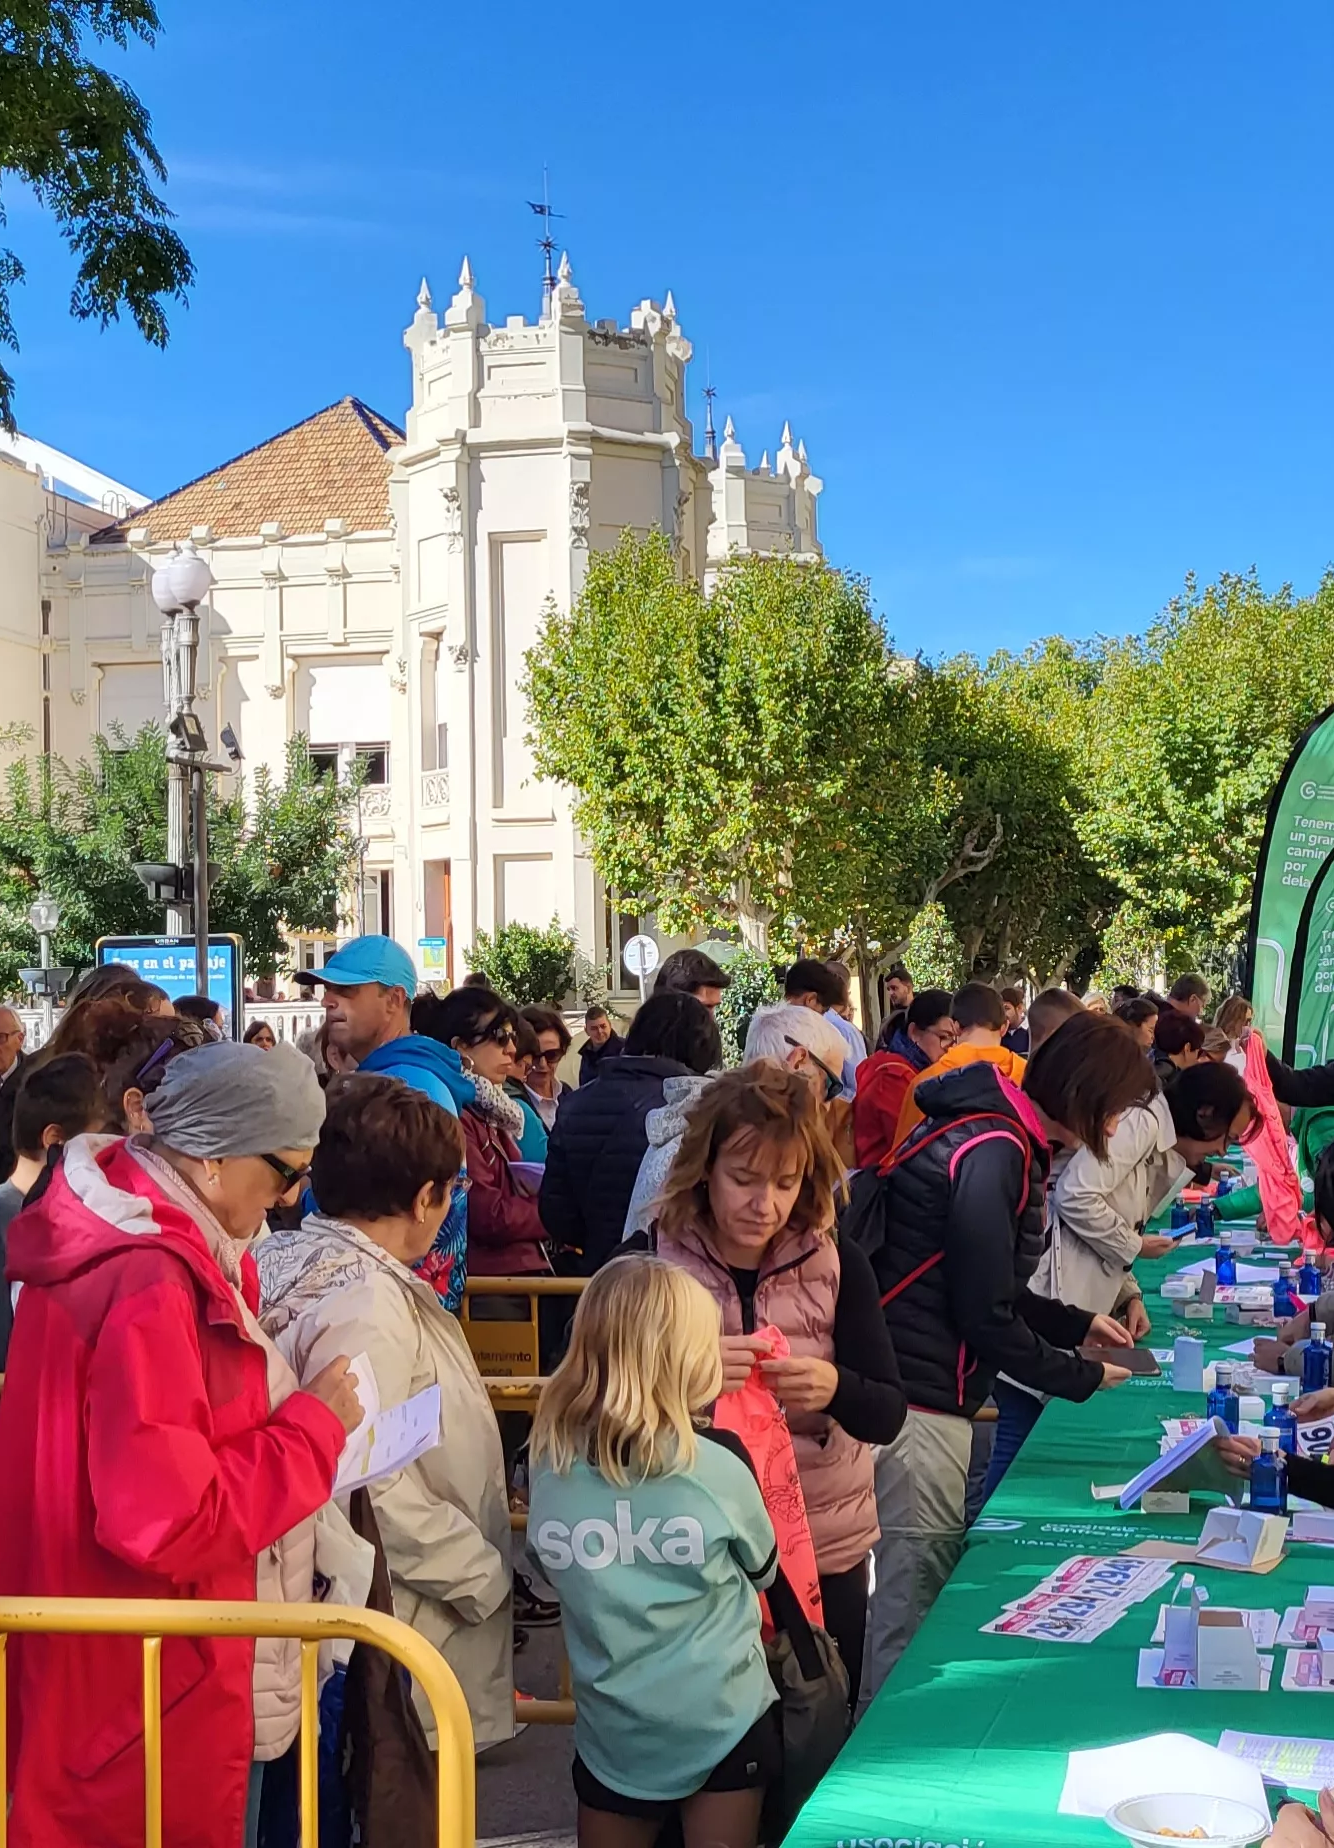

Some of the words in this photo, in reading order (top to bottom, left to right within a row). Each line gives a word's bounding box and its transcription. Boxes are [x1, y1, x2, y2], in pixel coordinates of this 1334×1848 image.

[1289, 831, 1306, 842] un
[1284, 861, 1307, 873] por
[1282, 874, 1312, 889] dela
[143, 959, 159, 969] en
[163, 956, 175, 969] el
[1316, 972, 1334, 983] por
[538, 1500, 706, 1560] soka
